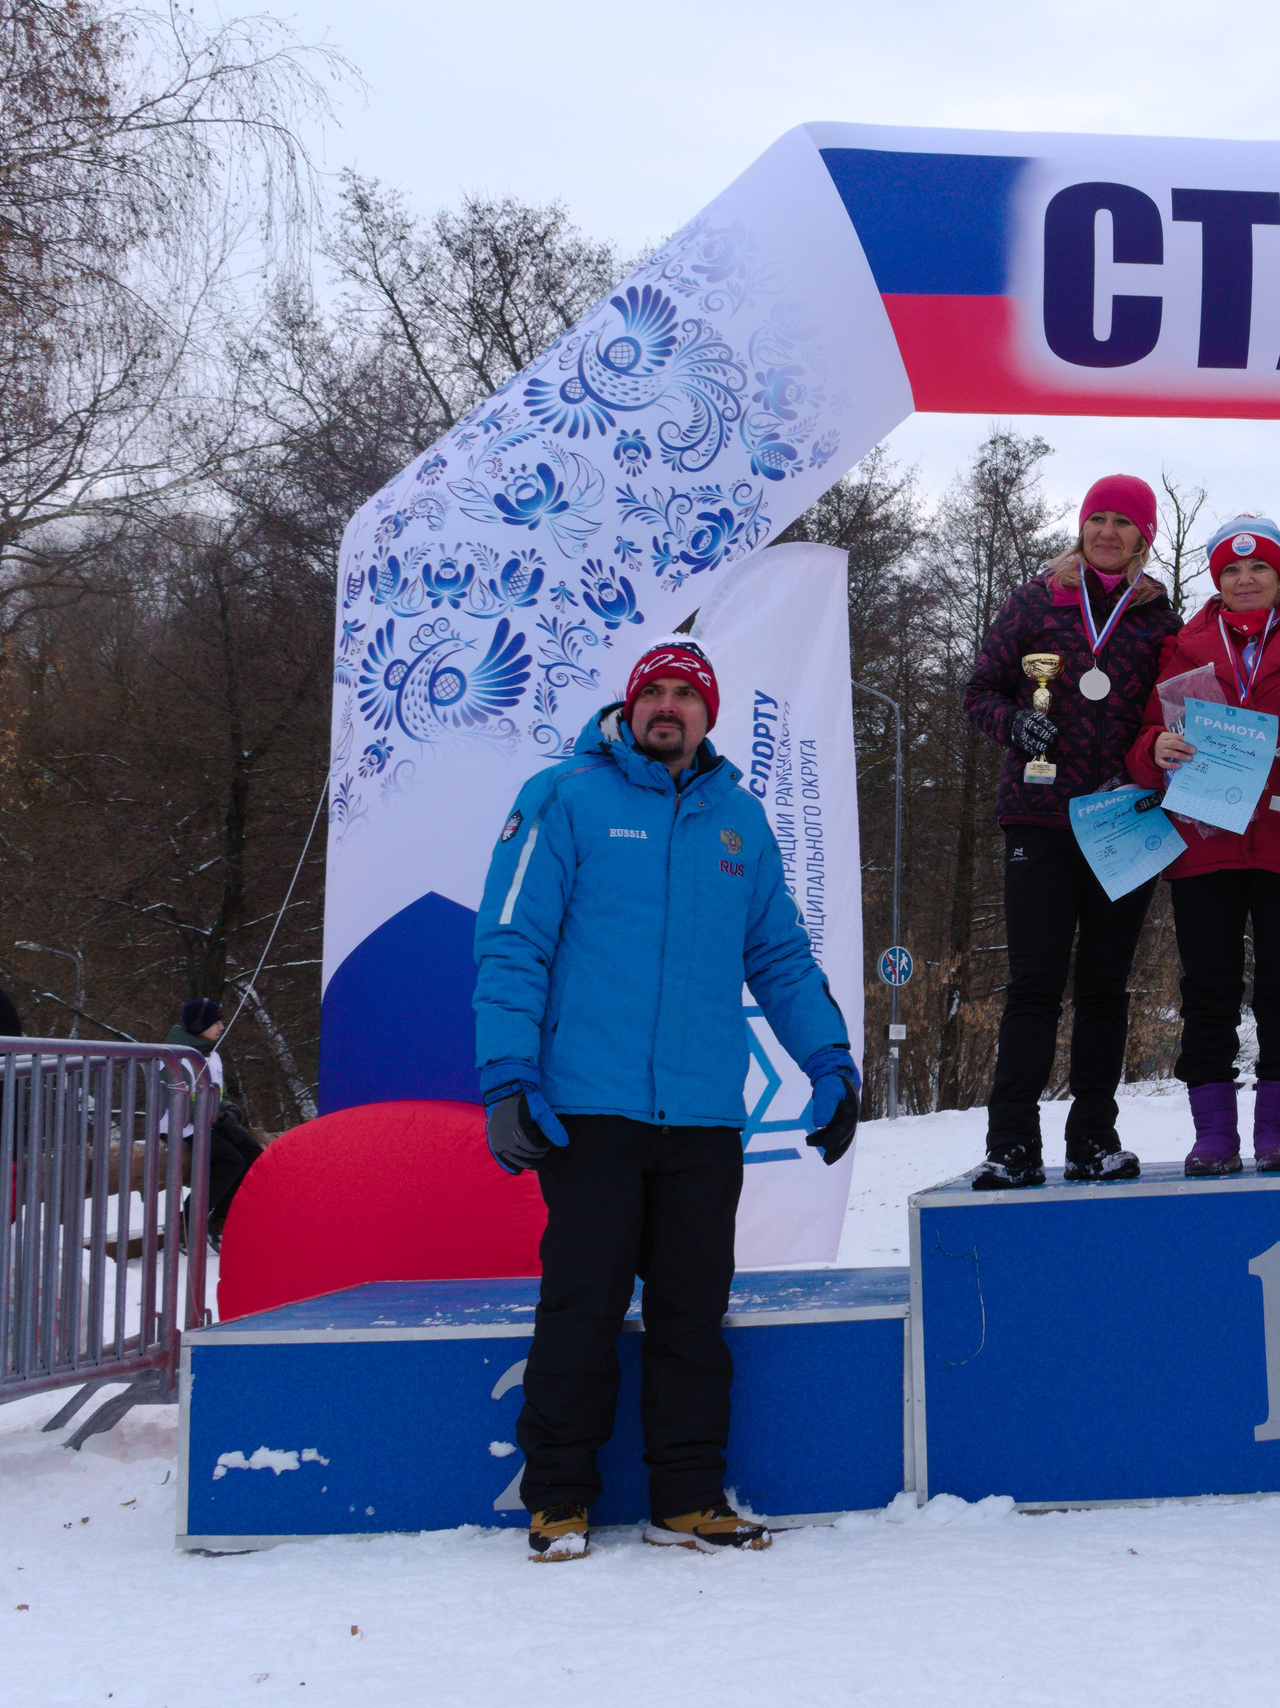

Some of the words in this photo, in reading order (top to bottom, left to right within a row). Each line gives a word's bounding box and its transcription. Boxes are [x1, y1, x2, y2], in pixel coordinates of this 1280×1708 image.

[1195, 715, 1267, 741] ГРАМОТА
[750, 689, 779, 799] СПОРТУ
[800, 739, 820, 801] ОКРУГА
[609, 828, 648, 840] RUSSIA
[719, 859, 745, 877] RUS
